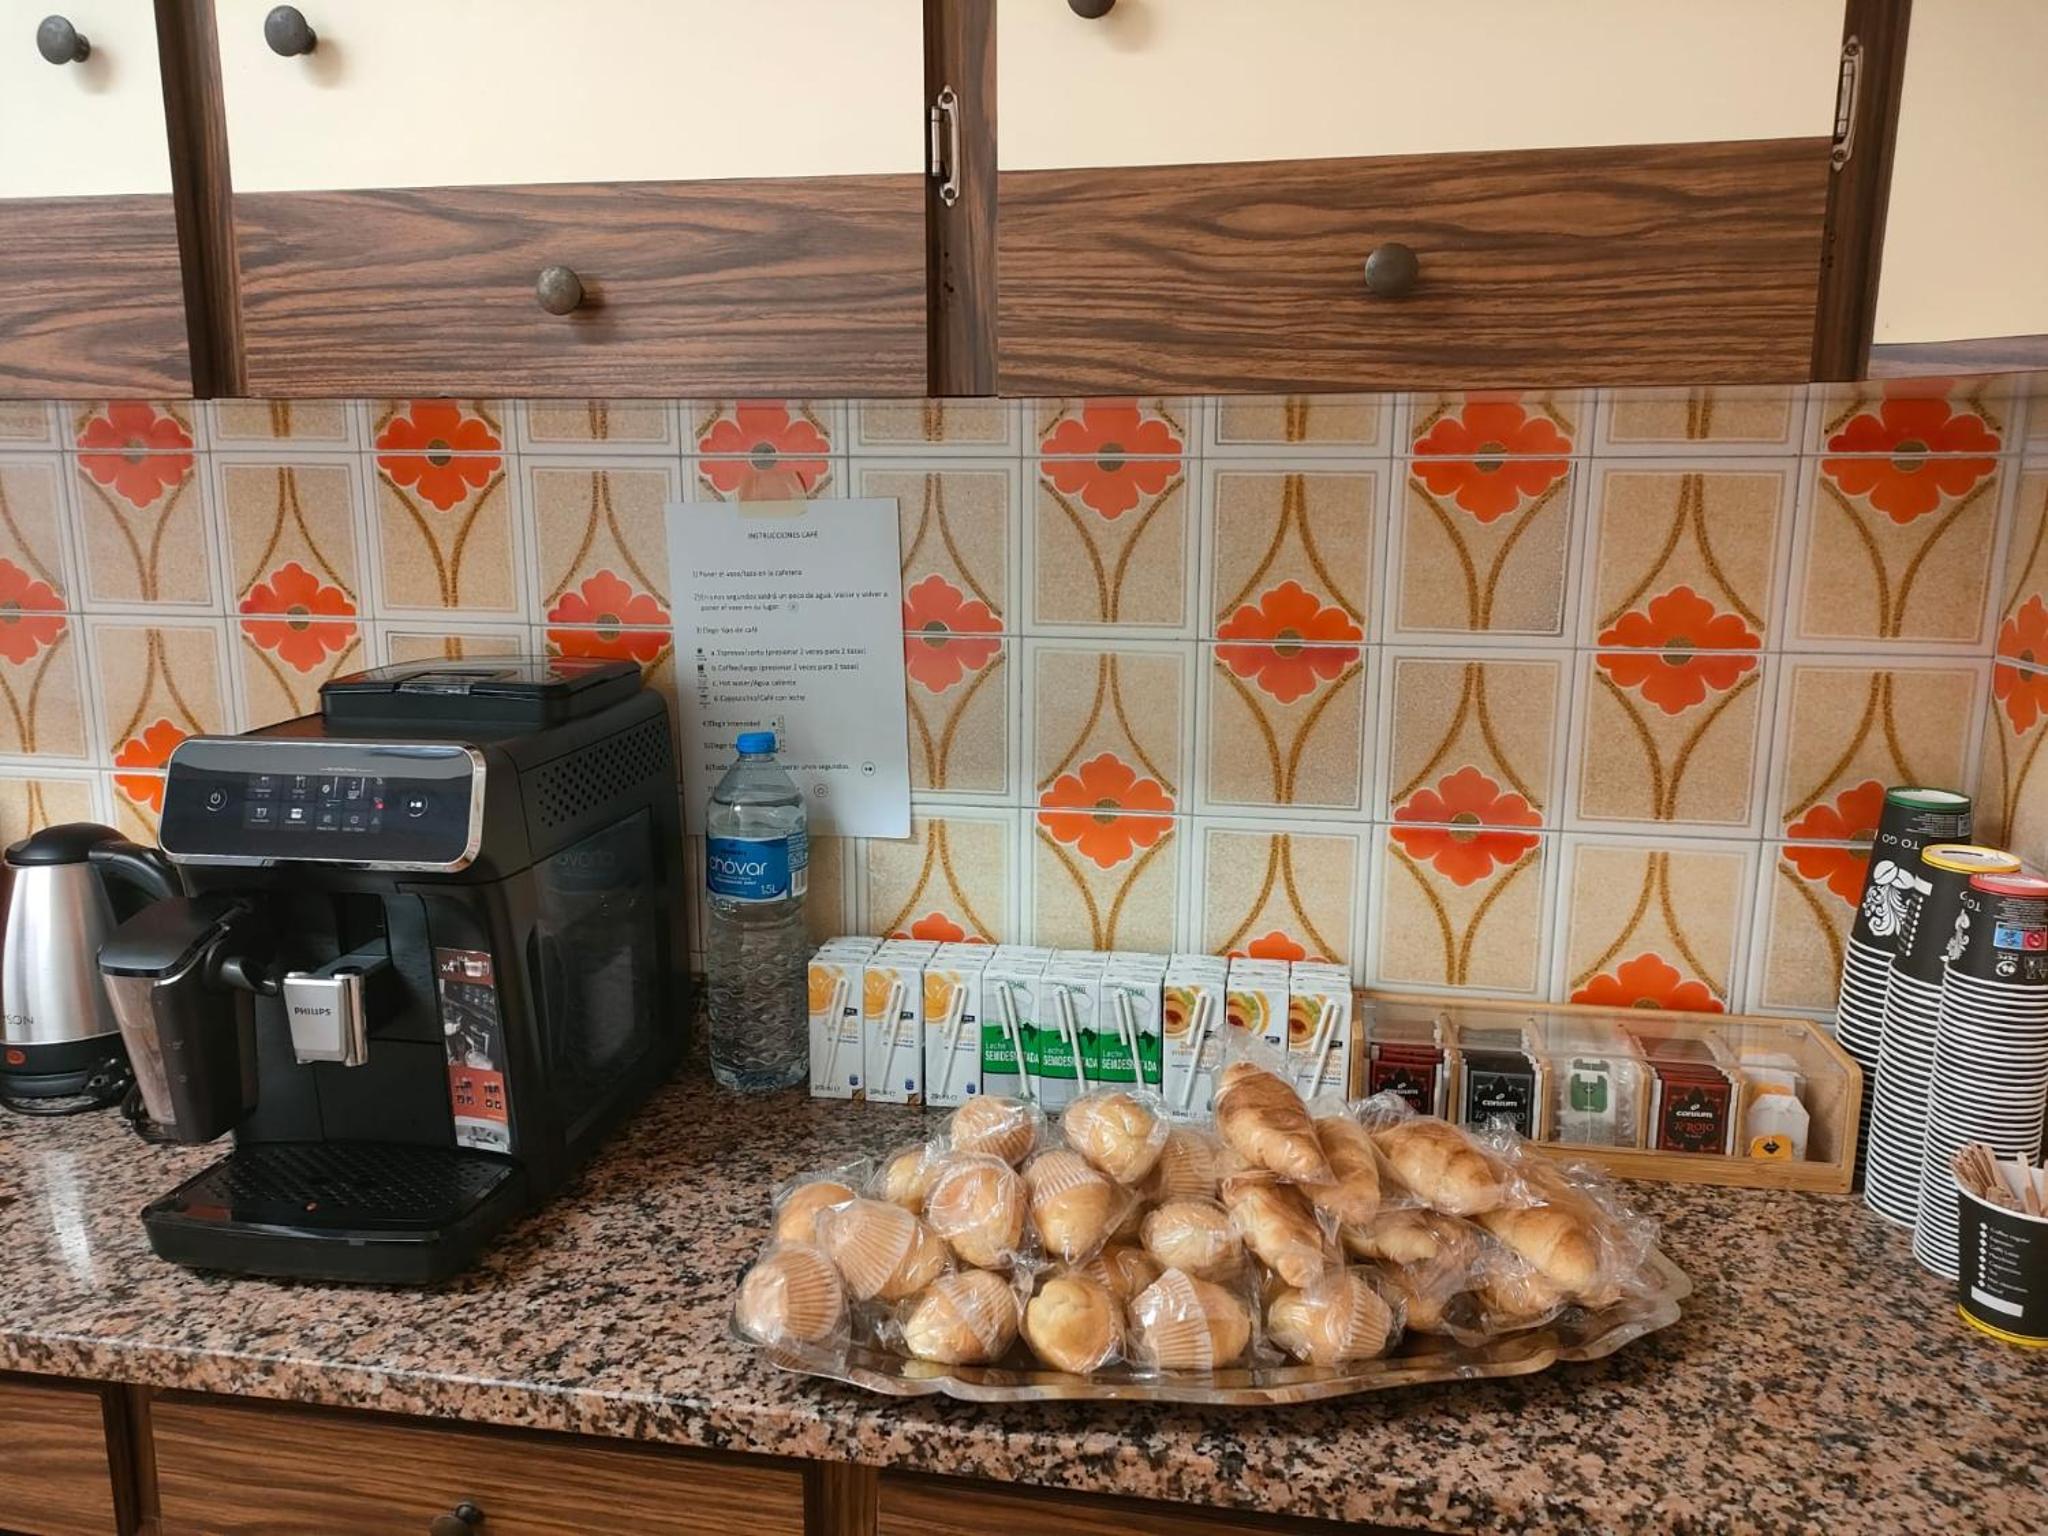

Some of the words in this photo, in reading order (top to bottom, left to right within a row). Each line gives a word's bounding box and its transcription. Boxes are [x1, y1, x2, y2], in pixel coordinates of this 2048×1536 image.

[1882, 833, 1898, 845] GO
[1901, 838, 1920, 850] TO
[294, 1006, 332, 1016] PHILIPS
[985, 1041, 1006, 1050] Leche
[1482, 1099, 1518, 1107] consum
[1676, 1110, 1714, 1119] consum
